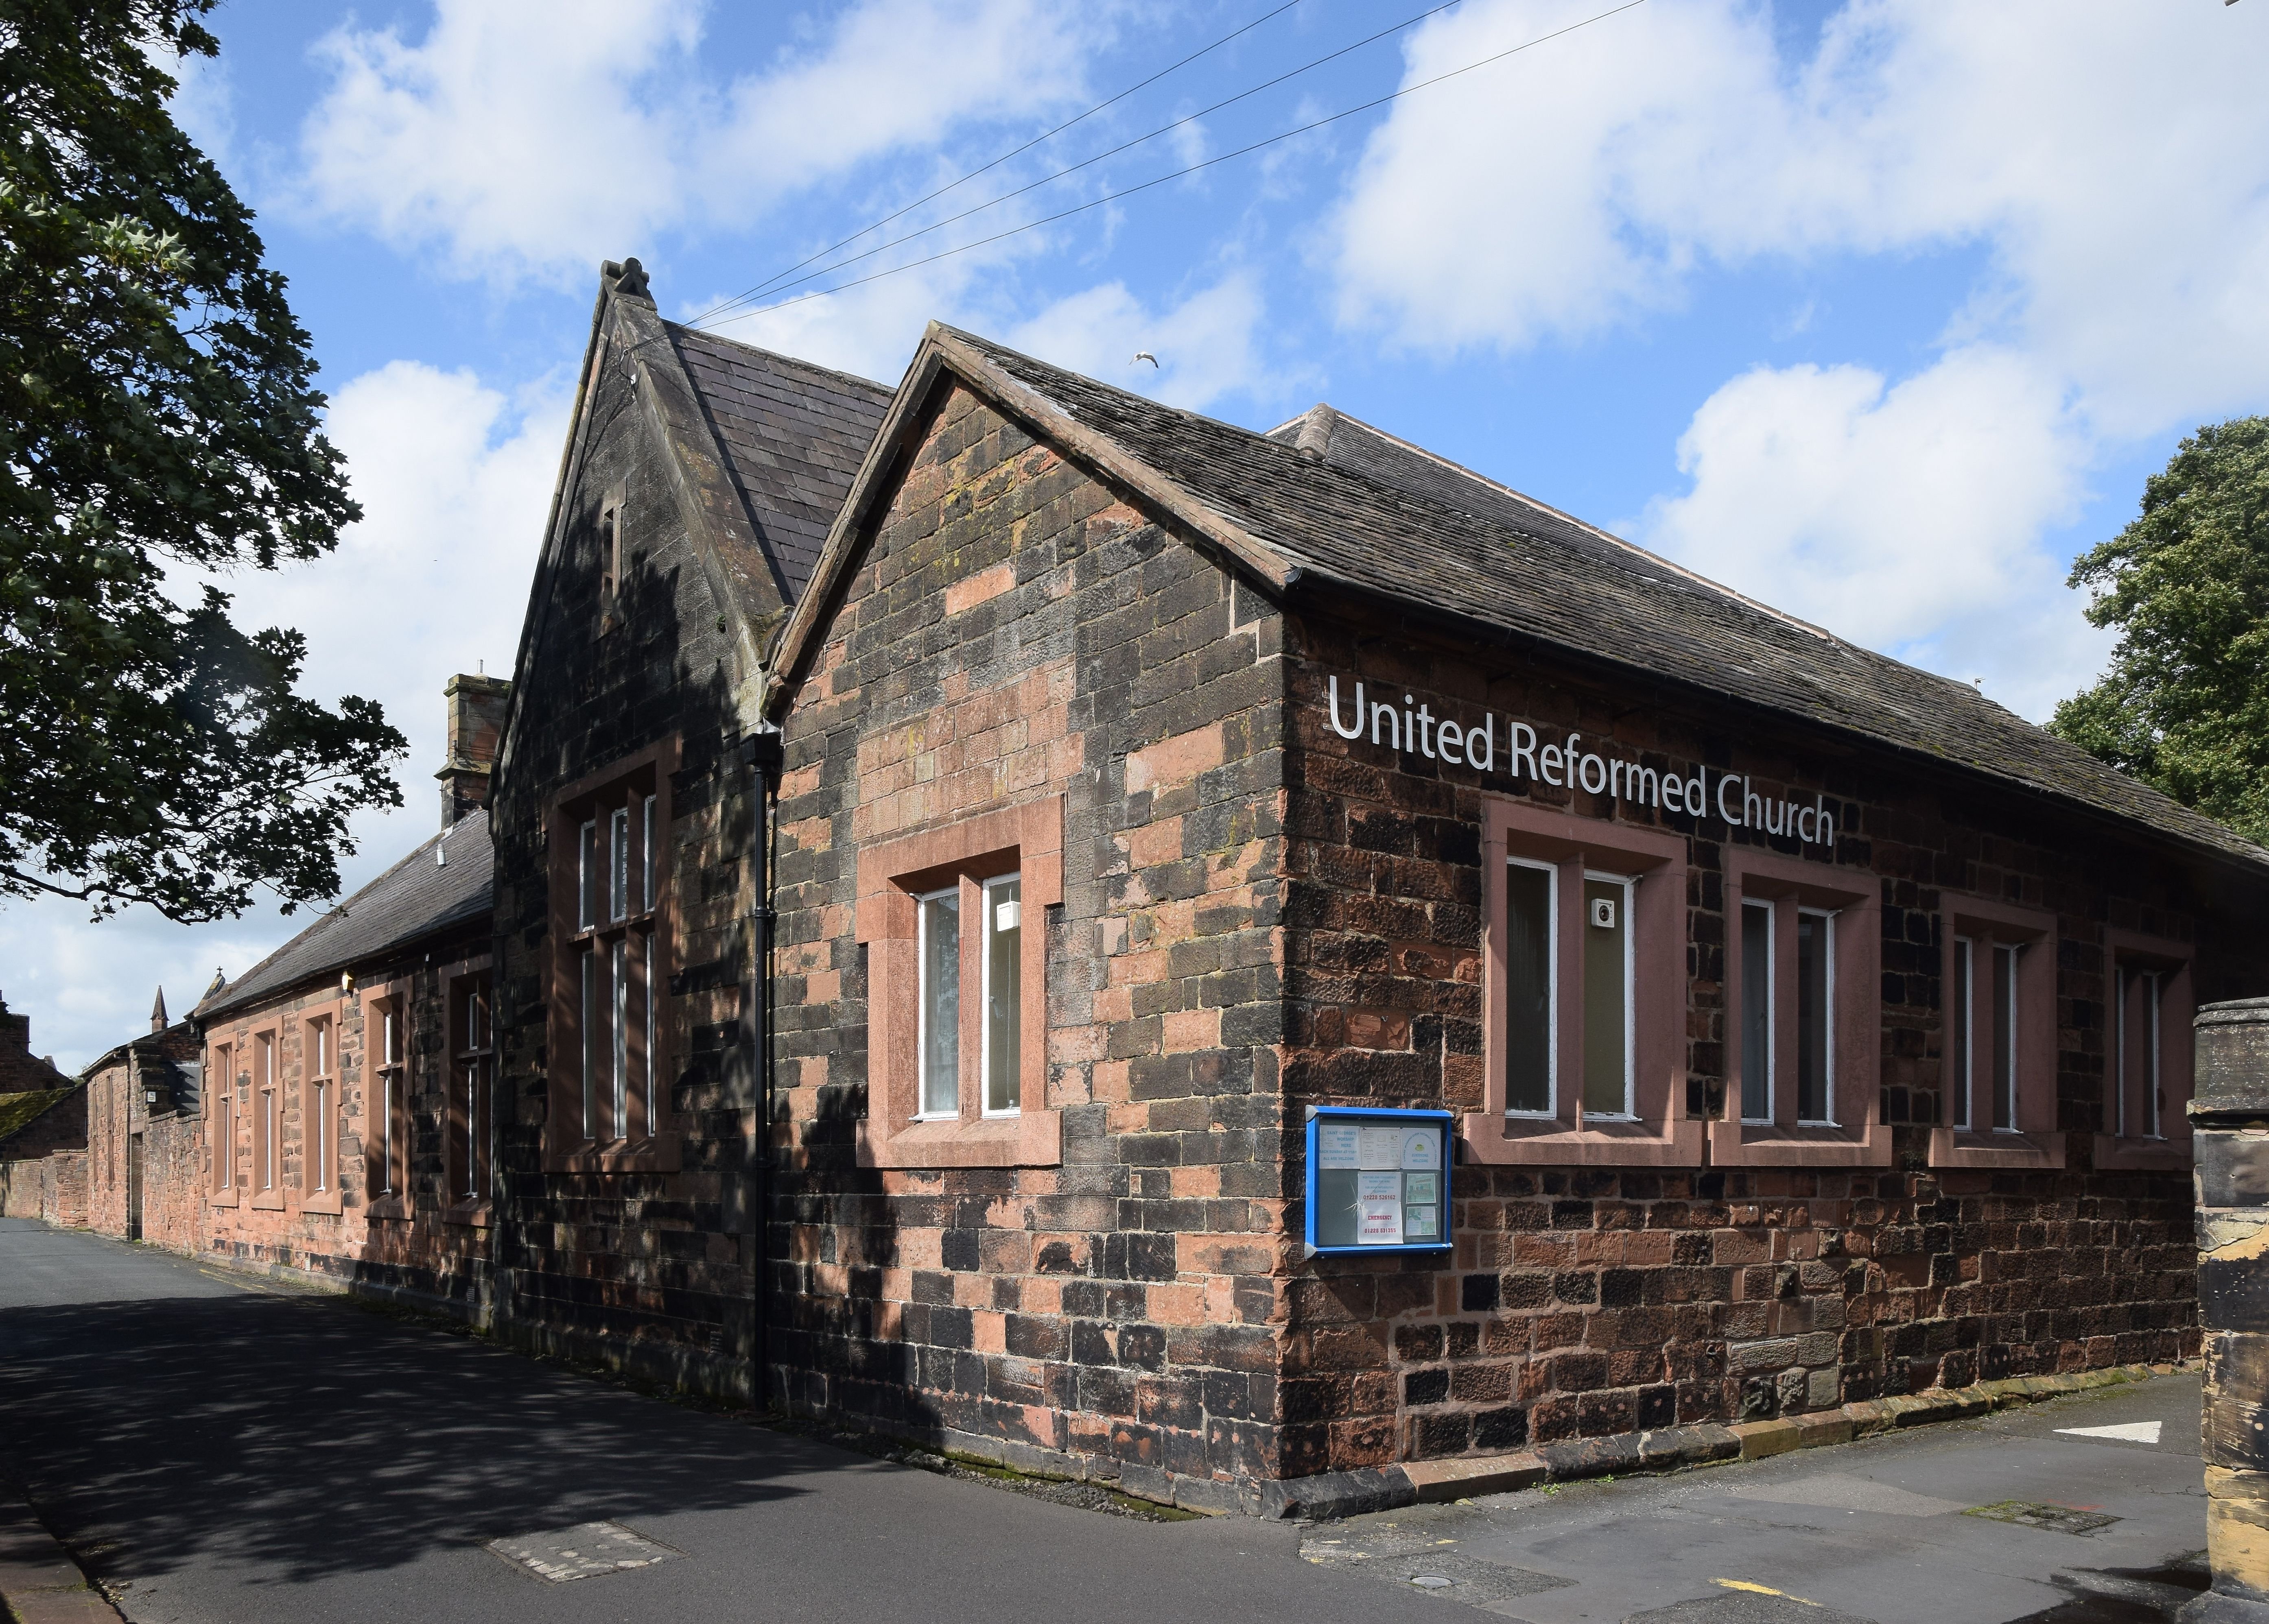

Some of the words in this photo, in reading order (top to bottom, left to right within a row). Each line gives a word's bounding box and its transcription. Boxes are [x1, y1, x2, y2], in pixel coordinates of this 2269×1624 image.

[1329, 675, 1493, 772] United
[1511, 722, 1707, 818] Reformed
[1717, 774, 1833, 847] Church
